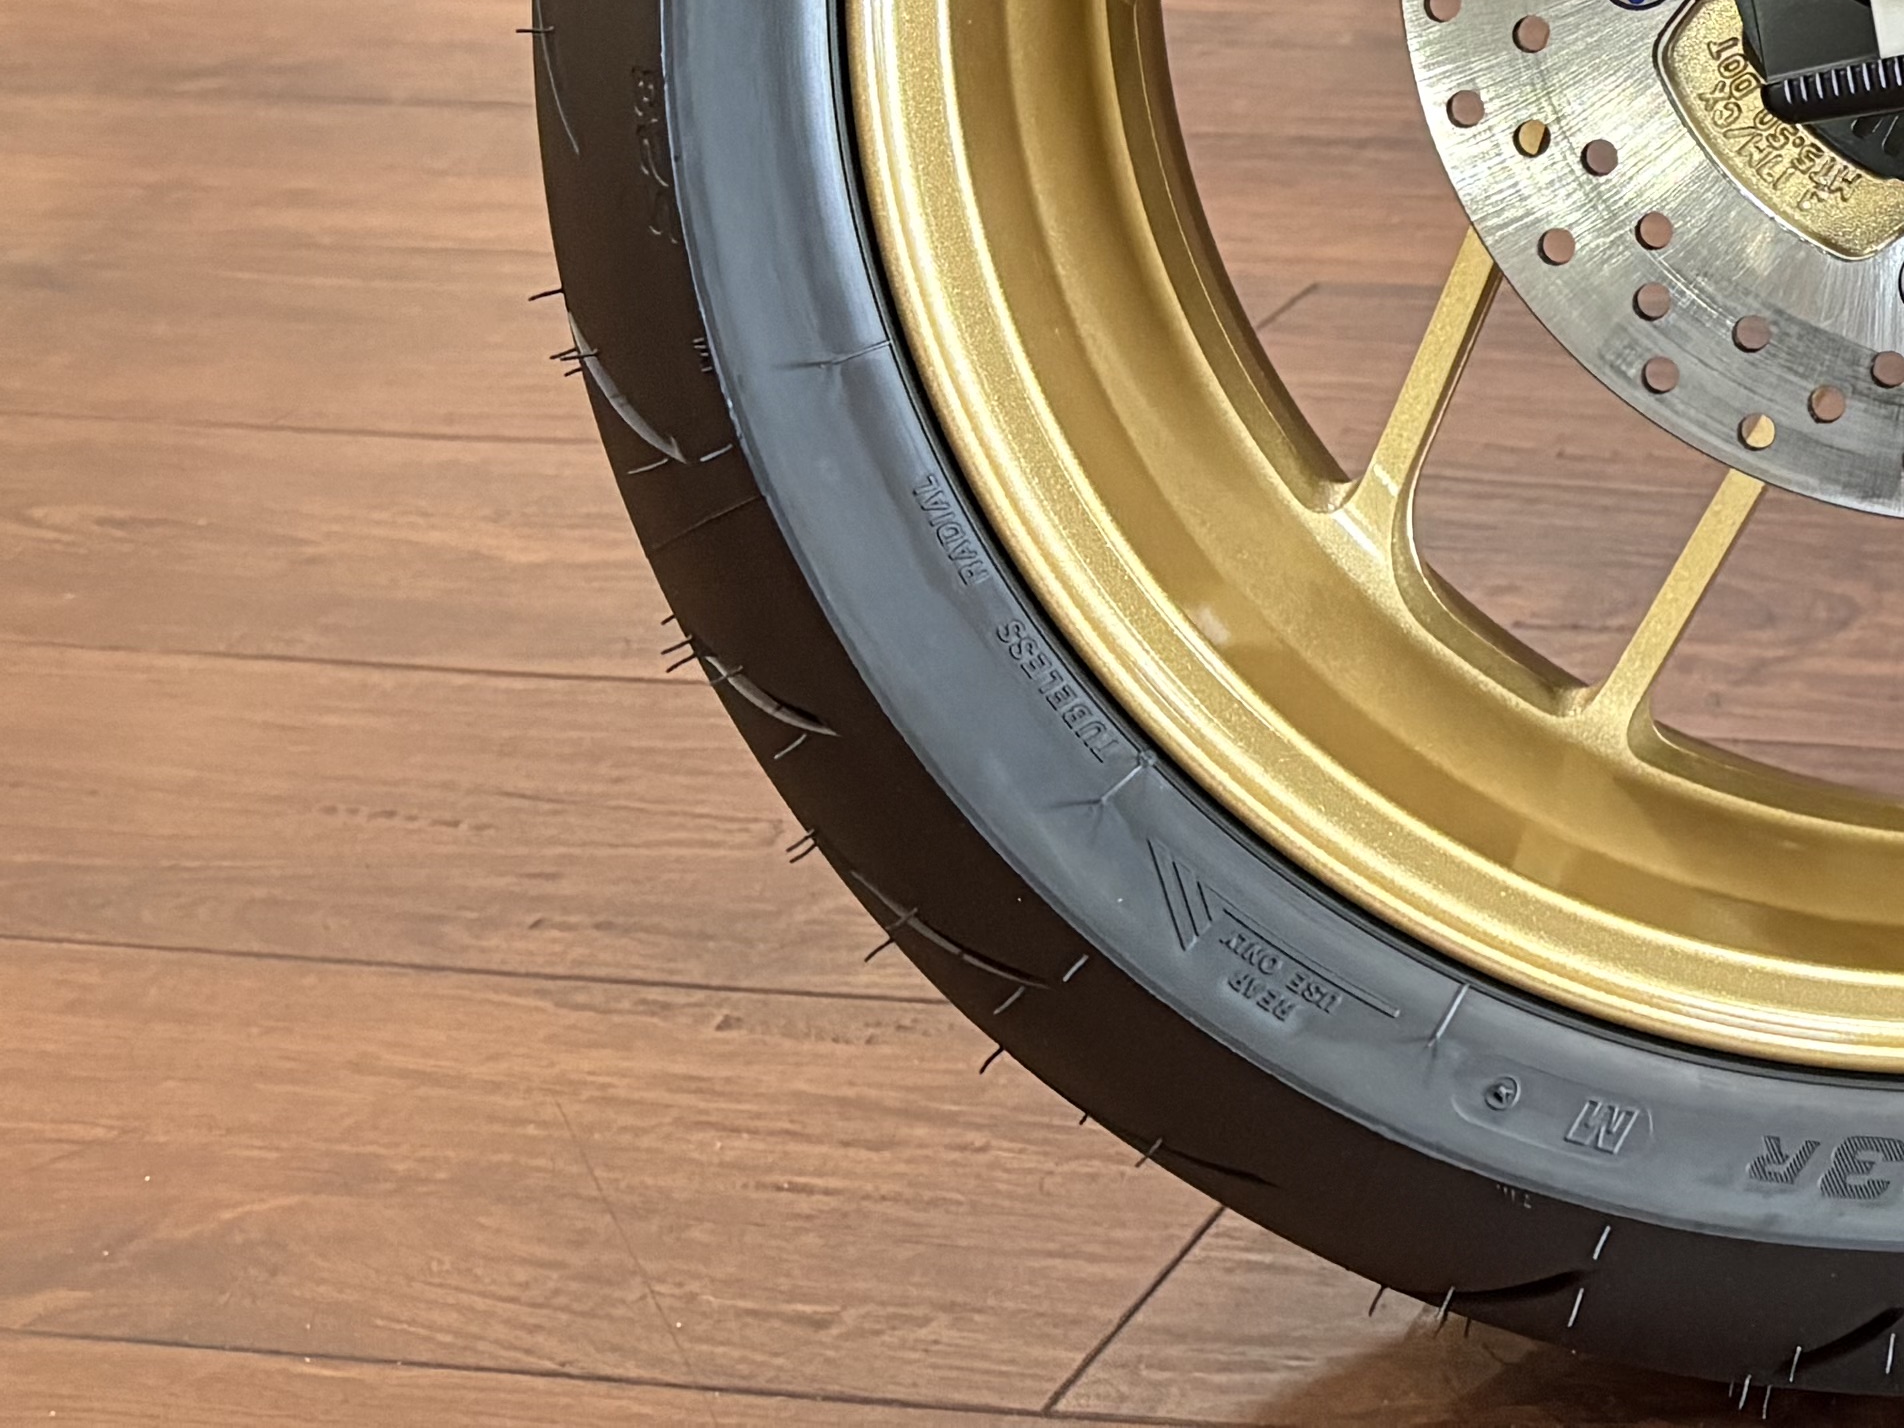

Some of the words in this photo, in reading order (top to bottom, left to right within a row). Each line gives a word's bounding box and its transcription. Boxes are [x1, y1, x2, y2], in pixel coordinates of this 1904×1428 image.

[913, 469, 991, 586] RADIAL
[994, 619, 1124, 765] TUBELESS
[1227, 968, 1299, 1023] REAR
[1284, 972, 1344, 1016] USE
